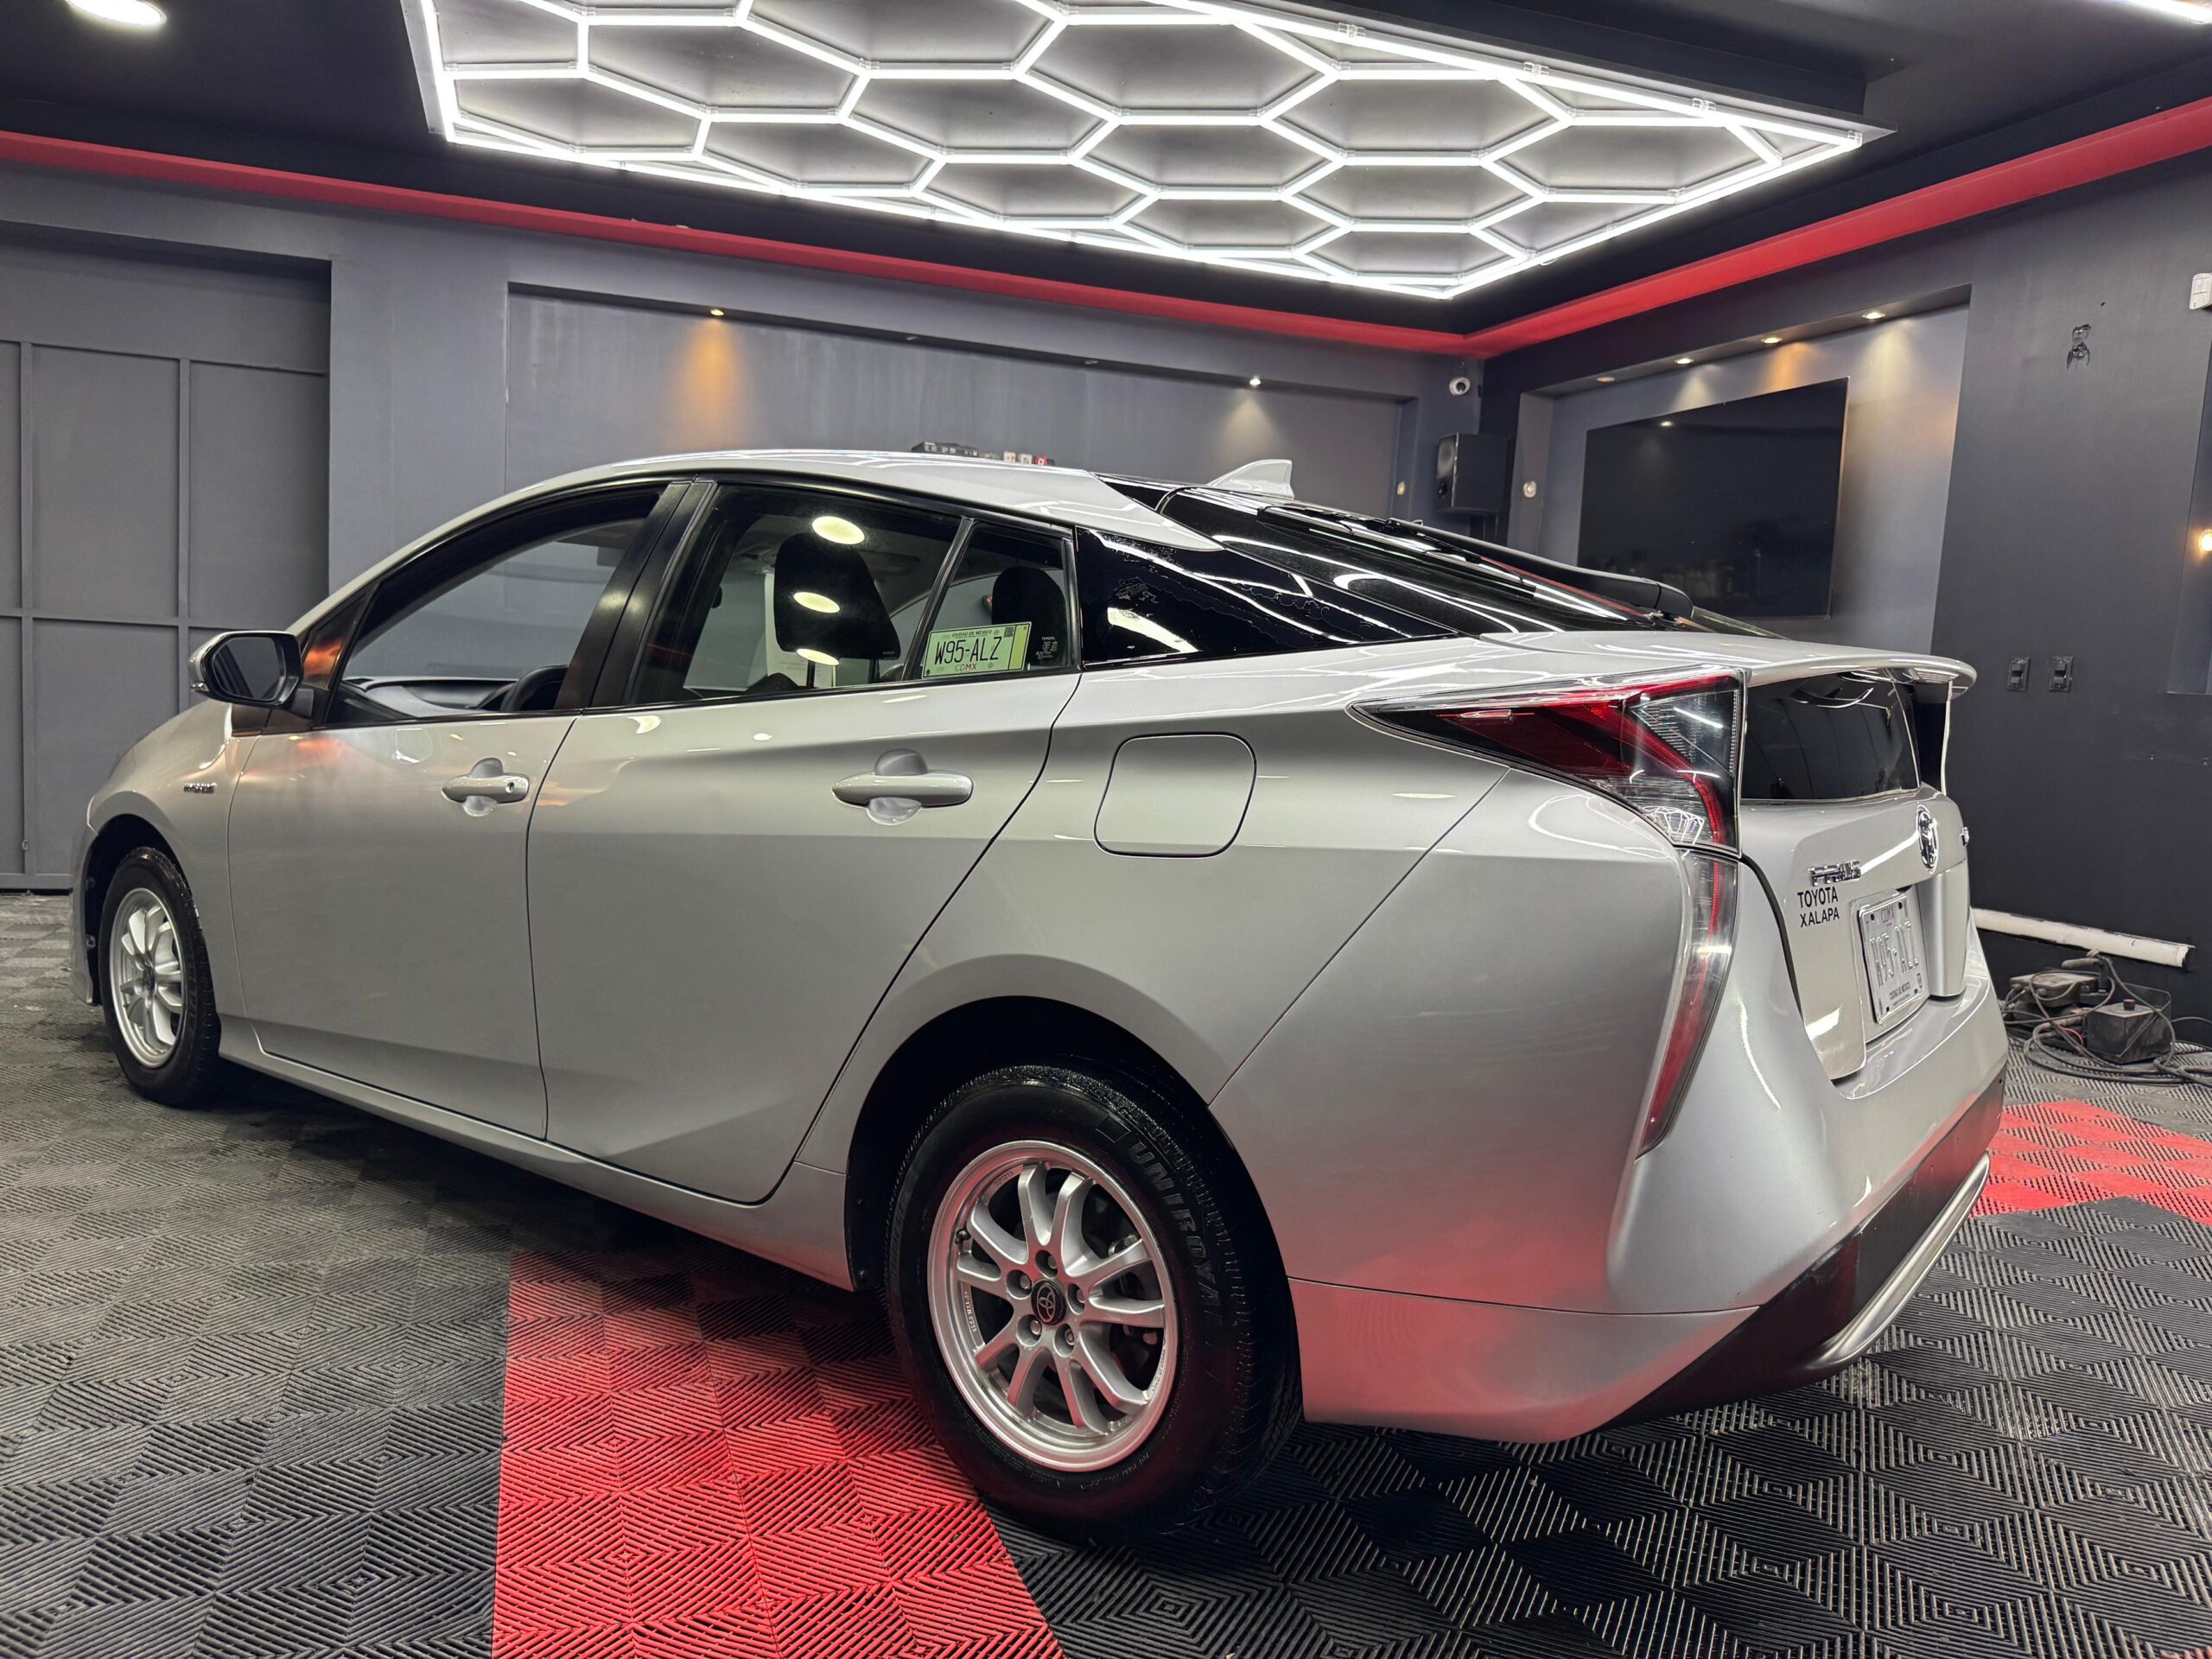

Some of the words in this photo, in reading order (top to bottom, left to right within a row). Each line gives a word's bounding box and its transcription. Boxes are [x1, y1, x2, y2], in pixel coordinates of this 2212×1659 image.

[934, 636, 1002, 665] W95-ALZ
[954, 663, 977, 671] CDMX
[1796, 886, 1839, 908] TOYOTA
[1799, 906, 1840, 928] XALAPA
